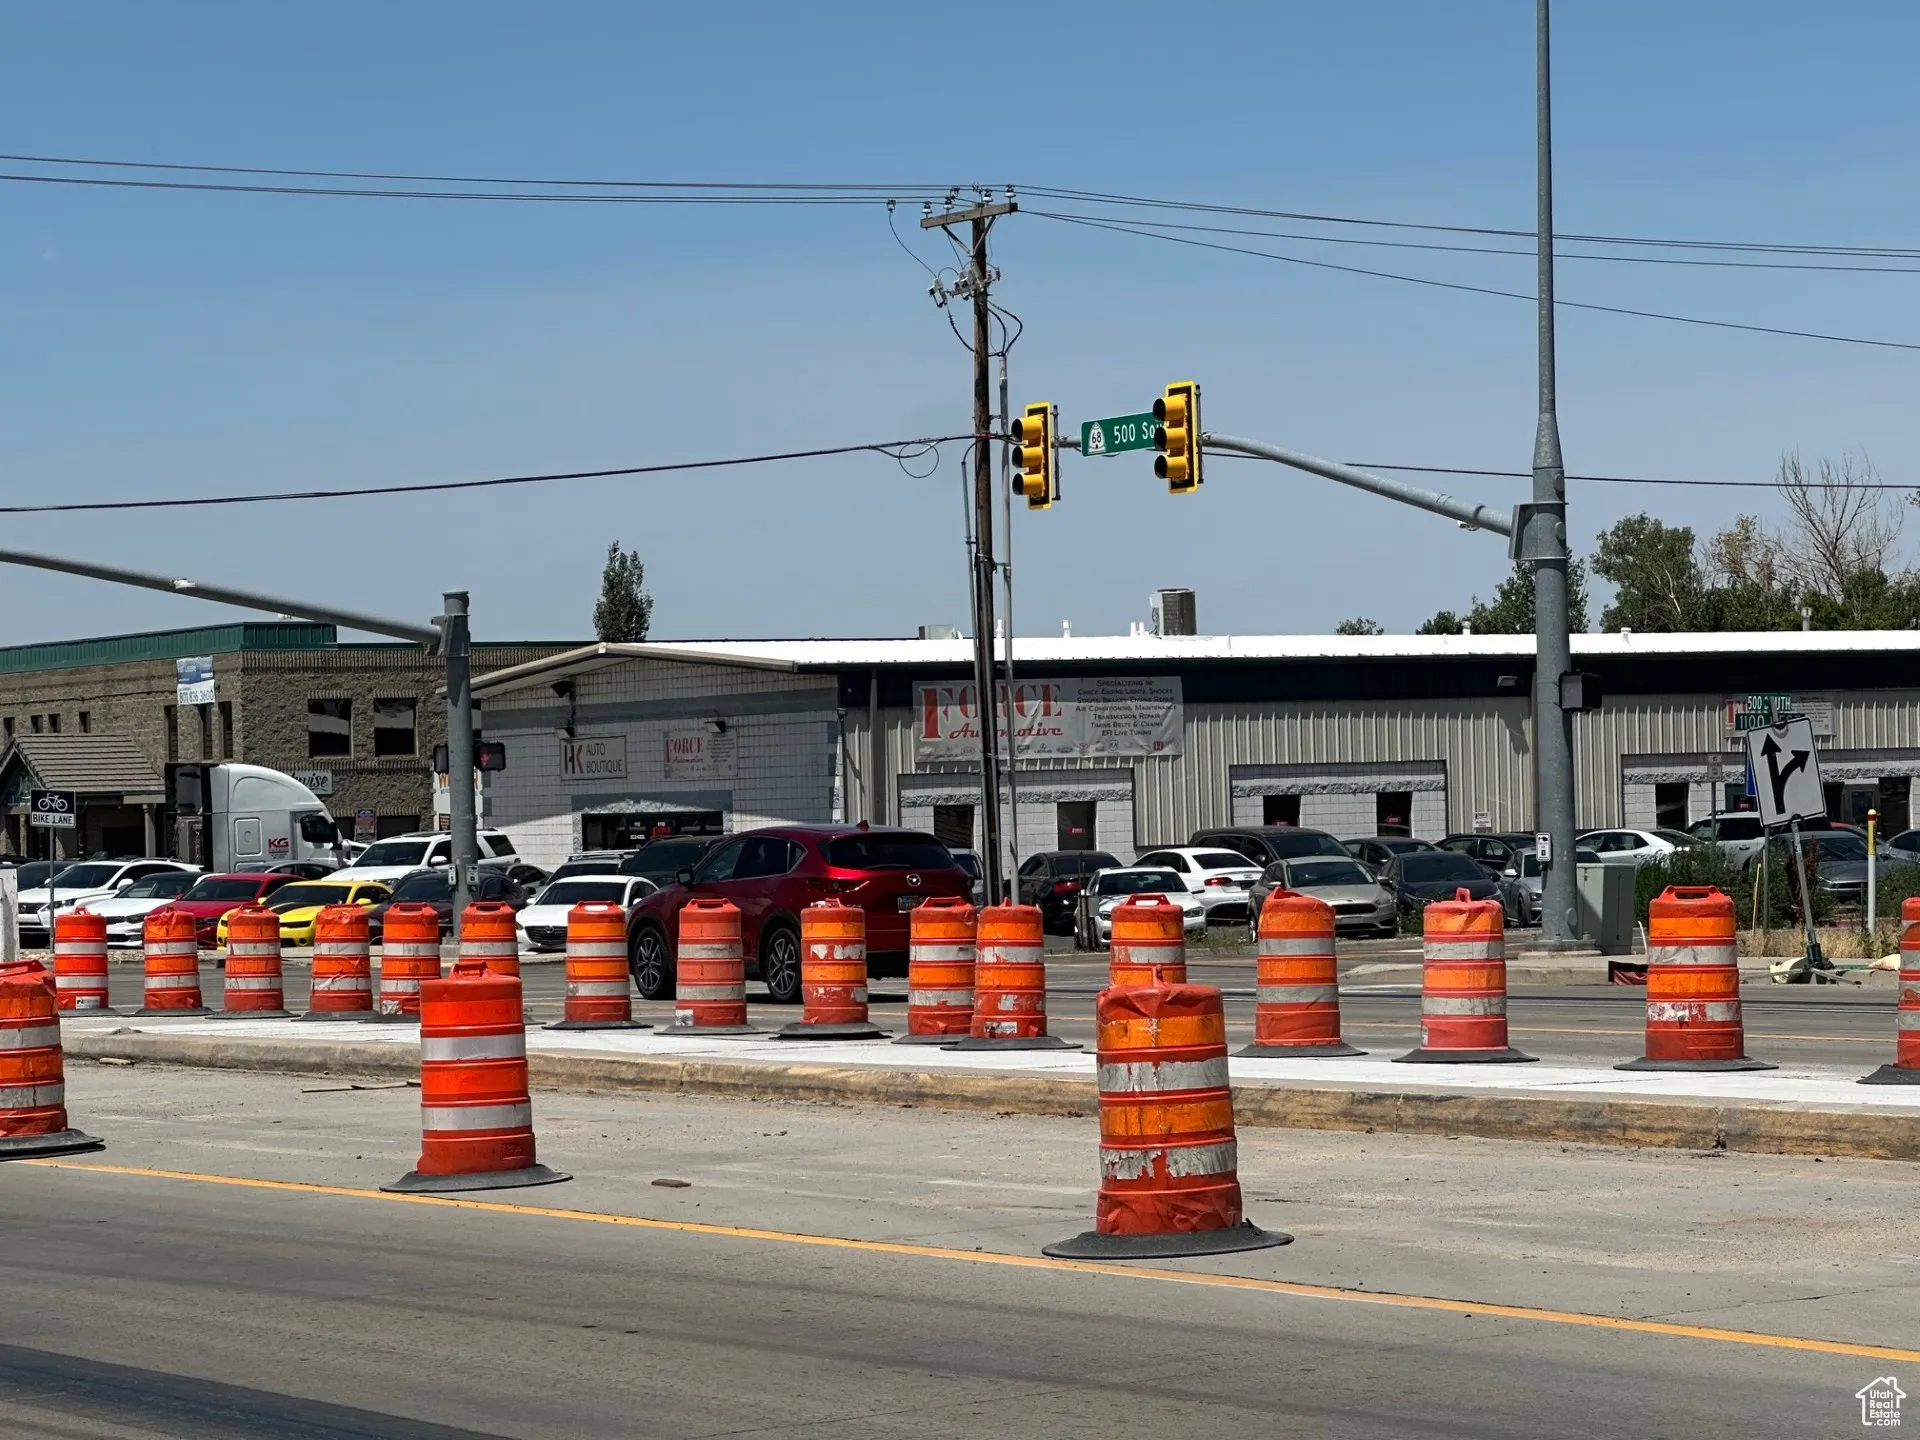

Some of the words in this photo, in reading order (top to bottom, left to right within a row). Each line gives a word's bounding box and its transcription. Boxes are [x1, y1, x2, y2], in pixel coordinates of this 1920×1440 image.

[1091, 431, 1102, 444] 68
[1113, 423, 1136, 444] 500
[1142, 421, 1162, 440] So
[1747, 695, 1763, 710] 500
[1763, 696, 1791, 711] SUTH
[1739, 715, 1765, 729] 1100
[948, 721, 1063, 740] Aumotive
[586, 743, 606, 756] AUTO
[664, 736, 704, 765] FORCE
[586, 759, 623, 774] BOUTIQUE
[291, 772, 329, 788] wise
[33, 813, 50, 824] BIKE
[53, 814, 73, 825] LANE
[268, 837, 289, 849] KG
